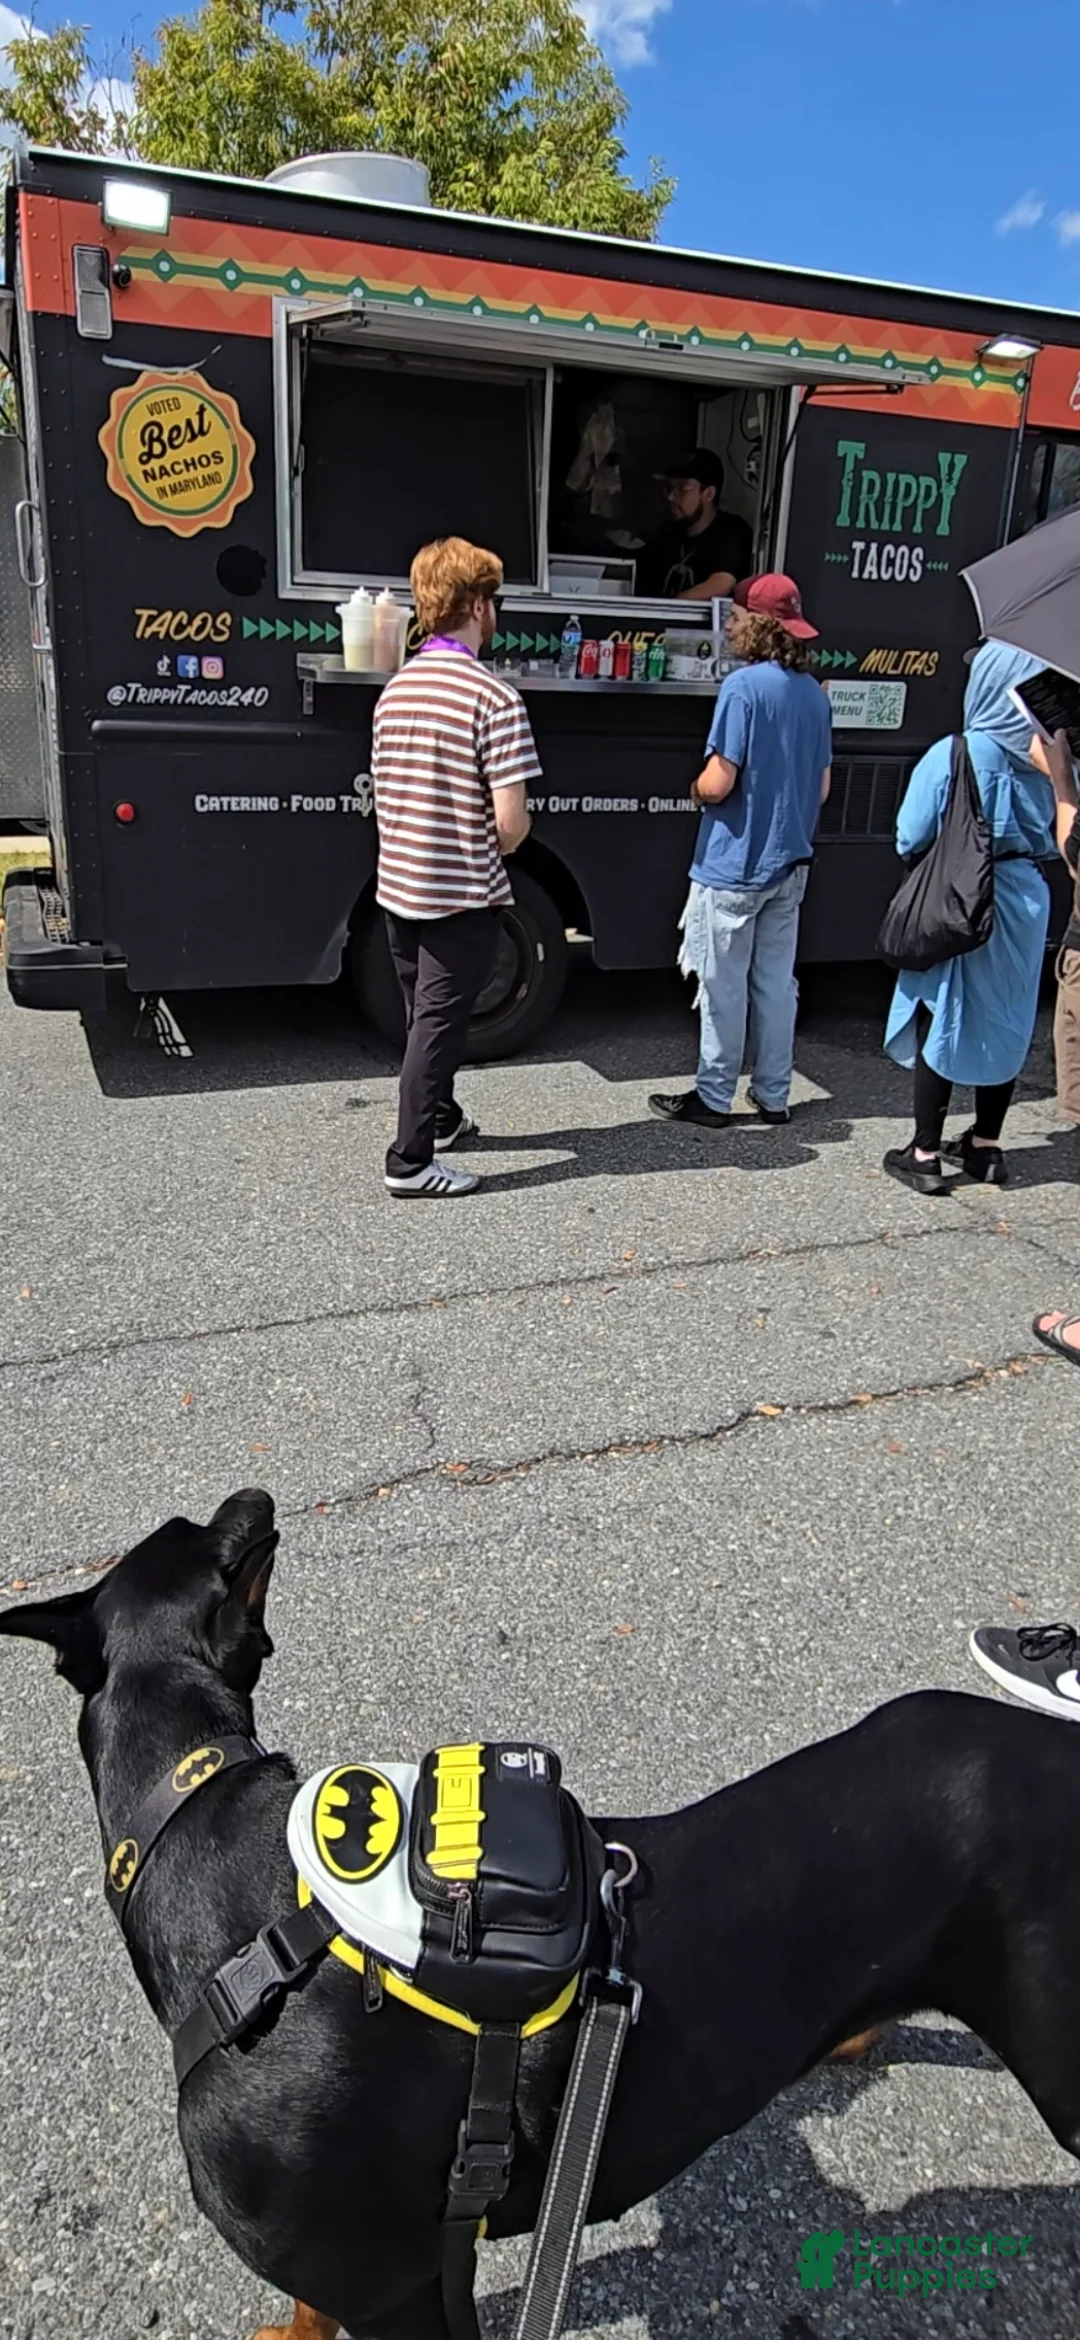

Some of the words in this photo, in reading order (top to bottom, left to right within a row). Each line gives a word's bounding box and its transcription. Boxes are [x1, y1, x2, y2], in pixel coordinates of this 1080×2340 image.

[145, 397, 181, 417] VOTED
[138, 403, 212, 465] Best
[141, 450, 225, 484] NACHOS
[155, 485, 169, 500] IN
[168, 471, 223, 497] MARYLAND
[835, 440, 968, 535] TRIPPY
[851, 541, 924, 582] TACOS
[134, 608, 233, 642] TACOS
[858, 648, 940, 677] MULITAS
[106, 682, 270, 707] @TRIPPYTACOS240
[831, 691, 868, 703] TRUCK
[832, 705, 864, 717] MENU
[195, 794, 280, 812] CATERING
[290, 794, 336, 812] FOOD
[339, 795, 373, 812] TRU
[525, 798, 546, 812] RY
[549, 796, 579, 813] OUT
[581, 796, 639, 813] ORDERS
